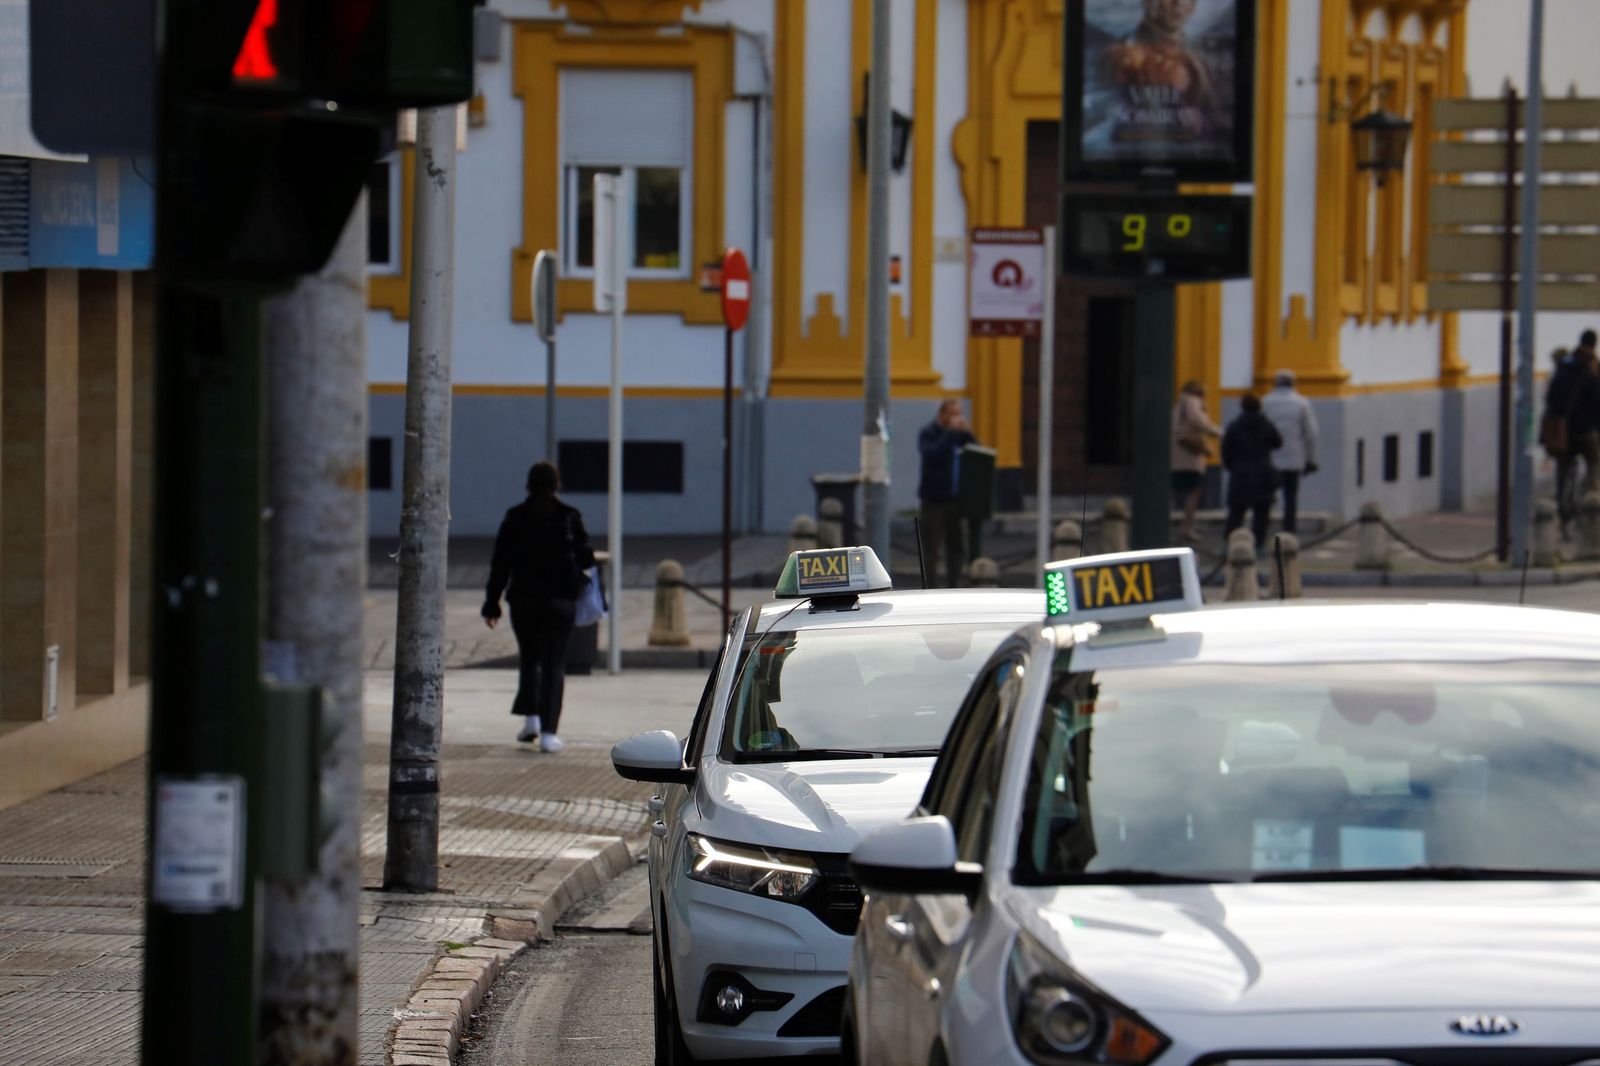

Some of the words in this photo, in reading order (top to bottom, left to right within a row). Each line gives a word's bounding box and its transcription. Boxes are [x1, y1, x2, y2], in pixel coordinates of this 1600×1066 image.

[1122, 214, 1147, 251] 9
[800, 555, 848, 577] TAXI
[1074, 562, 1155, 609] TAXI
[1459, 1013, 1513, 1033] KIA
